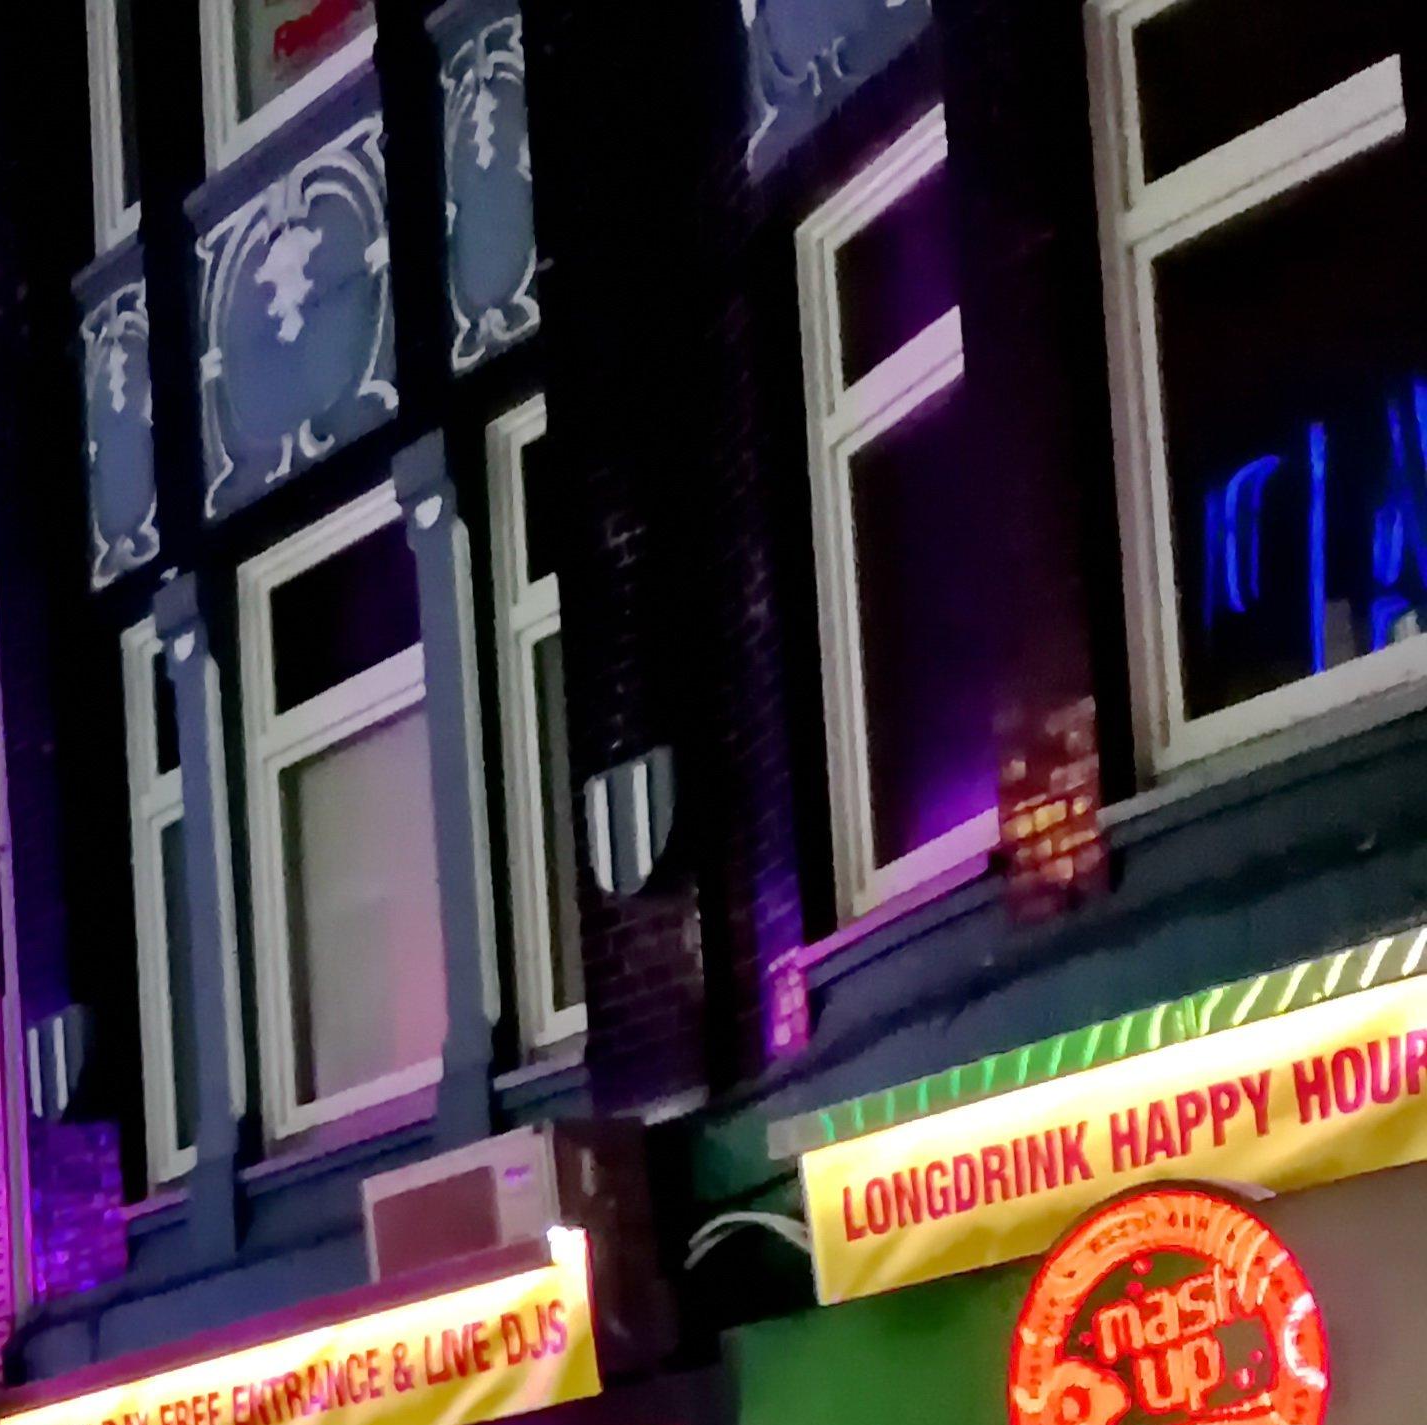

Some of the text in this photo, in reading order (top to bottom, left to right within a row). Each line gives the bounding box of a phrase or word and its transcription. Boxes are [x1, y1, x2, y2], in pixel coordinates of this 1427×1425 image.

[842, 1028, 1427, 1241] LONGDRINK HAPPY HOUR
[393, 1341, 415, 1392] &
[423, 1320, 492, 1386] LIVE
[499, 1298, 569, 1366] DJS
[1137, 1334, 1222, 1412] up
